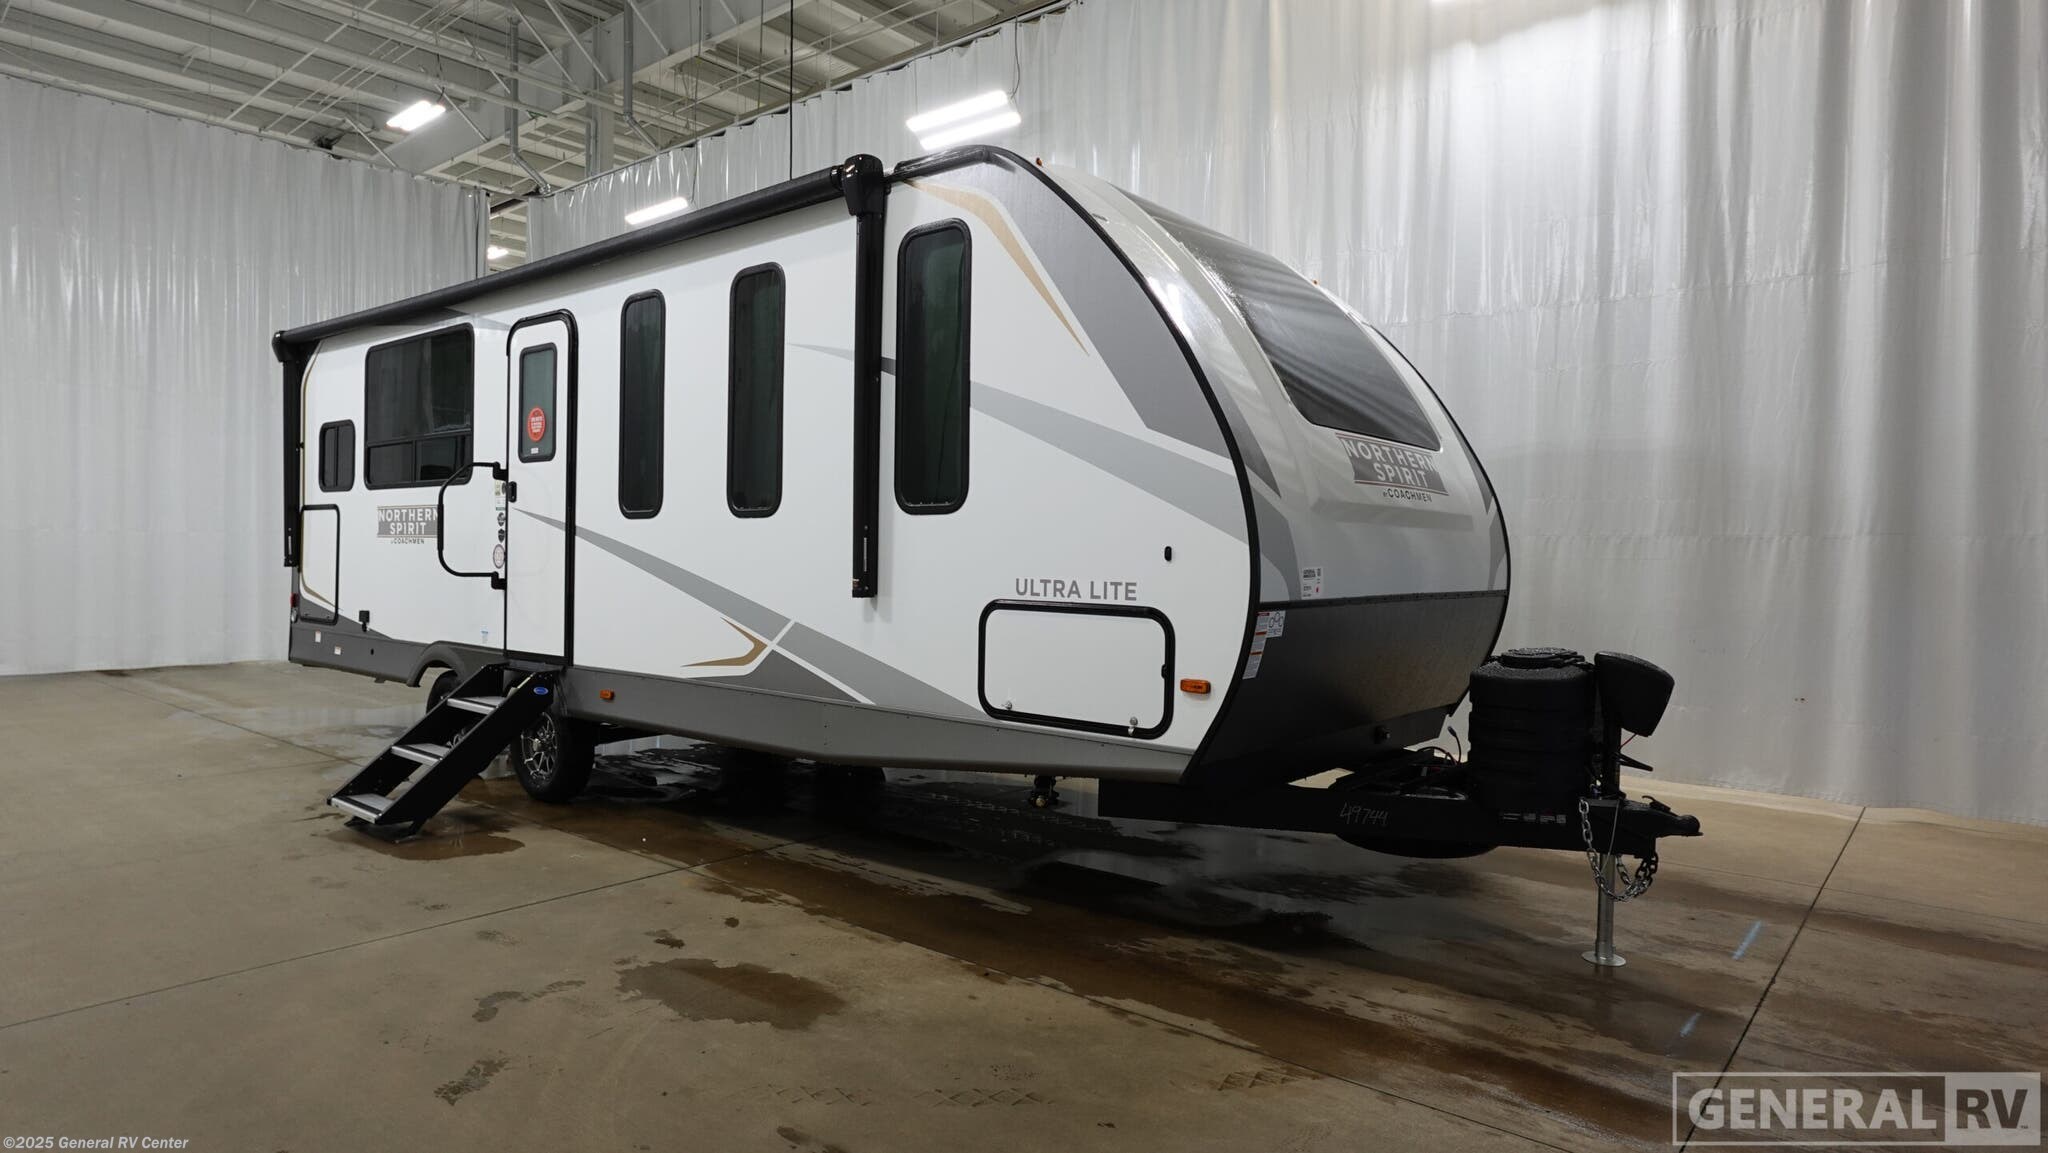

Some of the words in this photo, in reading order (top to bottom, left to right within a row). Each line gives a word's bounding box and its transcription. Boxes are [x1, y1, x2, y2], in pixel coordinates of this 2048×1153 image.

[1341, 439, 1436, 471] NORTHERN
[1373, 463, 1428, 487] SPIRIT
[1387, 488, 1433, 502] COACHMEN
[390, 522, 426, 535] SPIRIT
[1016, 578, 1081, 599] ULTRA
[1090, 580, 1137, 601] LITE
